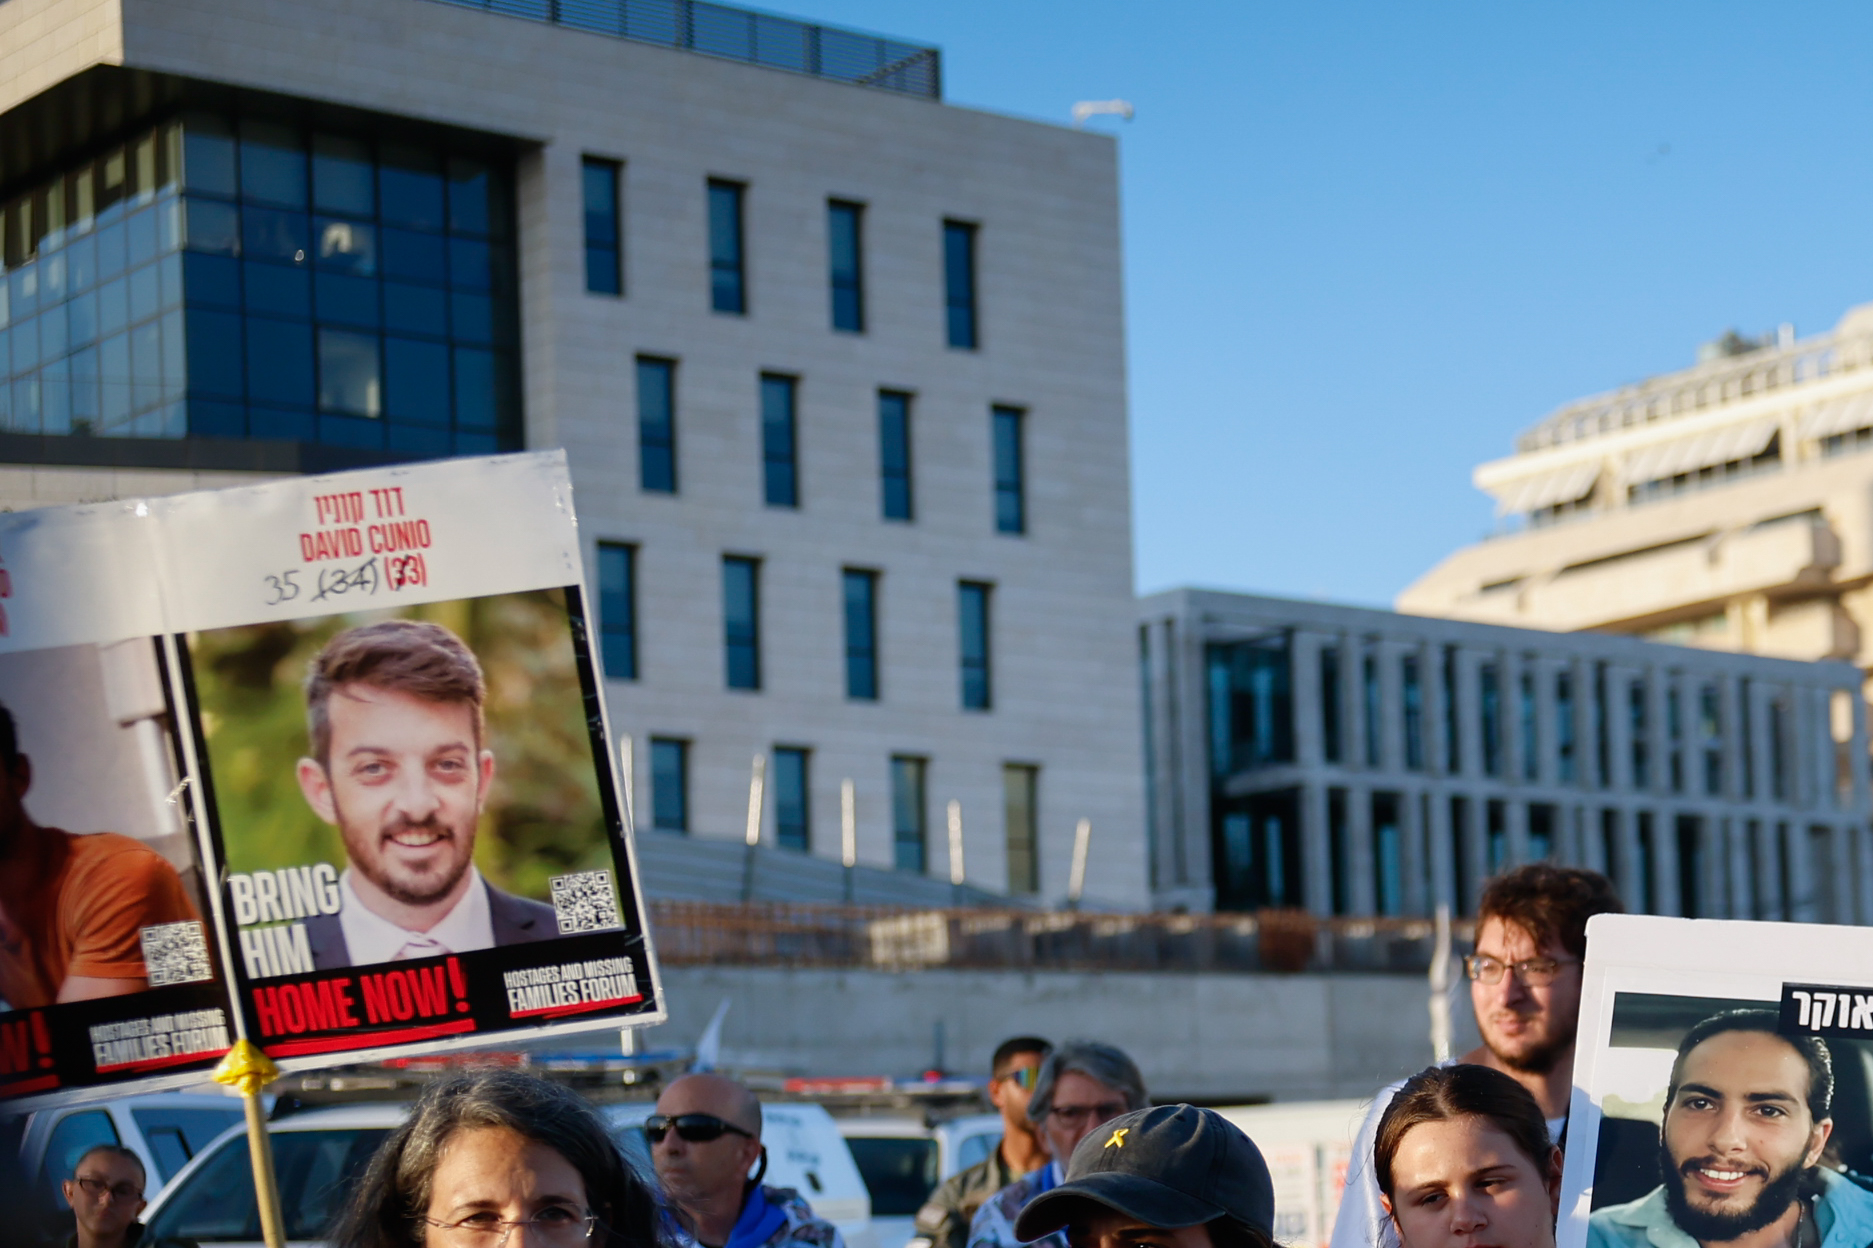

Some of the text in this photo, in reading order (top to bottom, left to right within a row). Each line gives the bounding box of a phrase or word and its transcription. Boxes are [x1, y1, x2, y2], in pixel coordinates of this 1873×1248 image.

[313, 487, 405, 525] דוד קוניו
[299, 519, 432, 562] DAVID CUNIO
[264, 570, 302, 605] 35
[228, 862, 341, 926] BRING
[239, 922, 317, 980] HIM
[503, 955, 635, 989] HOSTAGES AND MISSING
[252, 956, 471, 1038] HOME NOW!
[507, 973, 639, 1013] FAMILIES FORUM
